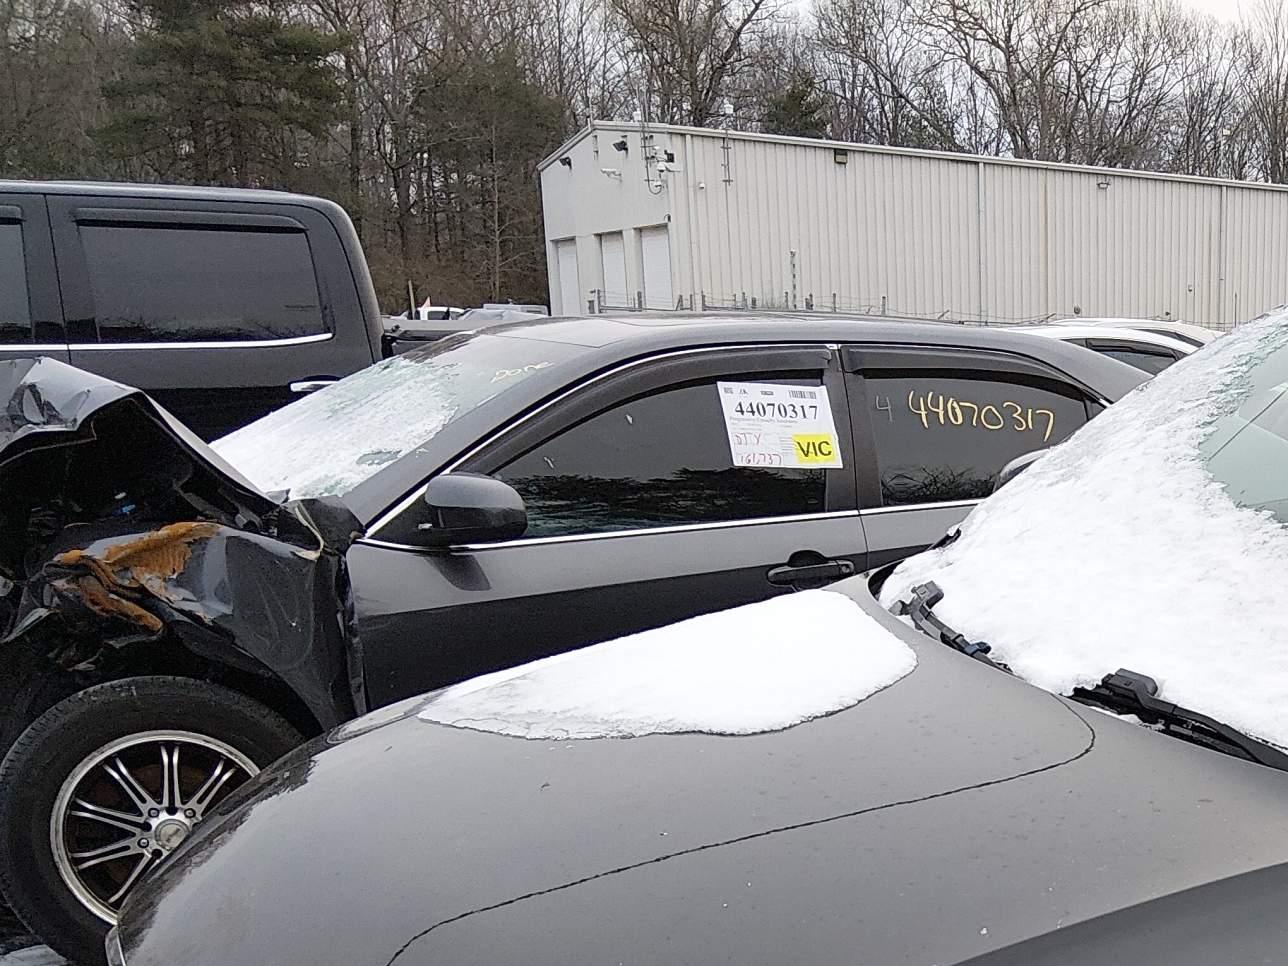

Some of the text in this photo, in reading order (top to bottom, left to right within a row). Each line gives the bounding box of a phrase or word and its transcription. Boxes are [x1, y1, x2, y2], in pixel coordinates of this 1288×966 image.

[734, 401, 818, 420] 44070317
[908, 390, 1054, 442] 44070317
[796, 440, 832, 458] VIC
